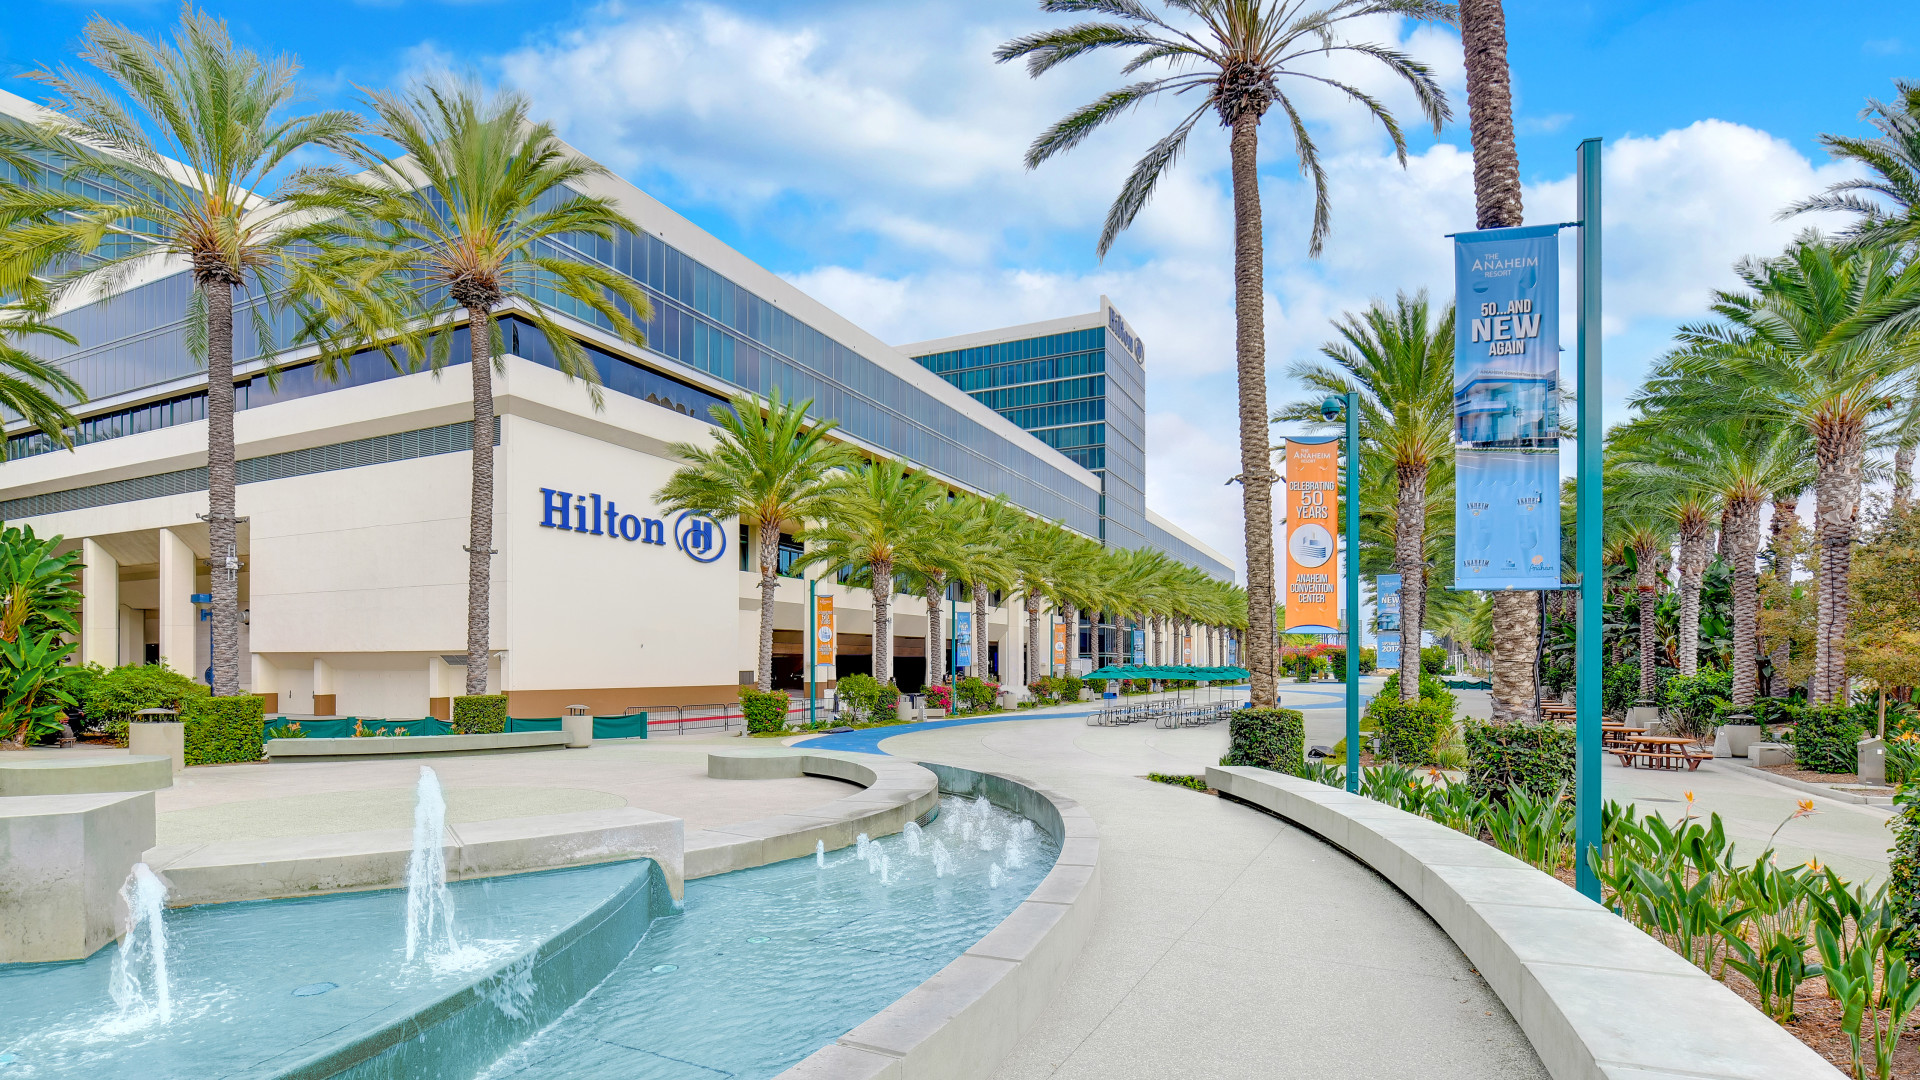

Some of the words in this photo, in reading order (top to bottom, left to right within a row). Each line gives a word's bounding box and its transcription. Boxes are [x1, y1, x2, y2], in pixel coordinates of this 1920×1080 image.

[1471, 256, 1539, 272] ANAHEIM
[1484, 270, 1512, 278] RESORT
[1481, 299, 1532, 317] 50...AND
[1471, 313, 1541, 343] NEW
[1489, 340, 1525, 356] AGAIN
[1293, 451, 1331, 459] ANAHEIM
[1289, 481, 1335, 491] CELEBRATING
[1301, 490, 1324, 506] 50
[539, 487, 666, 546] Hilton
[1296, 506, 1328, 519] YEARS
[1296, 573, 1329, 583] ANAHEIM
[1290, 583, 1335, 593] CONVENTION
[1298, 593, 1326, 603] CENTER
[1381, 596, 1400, 604] NEW
[1382, 645, 1400, 653] 2017
